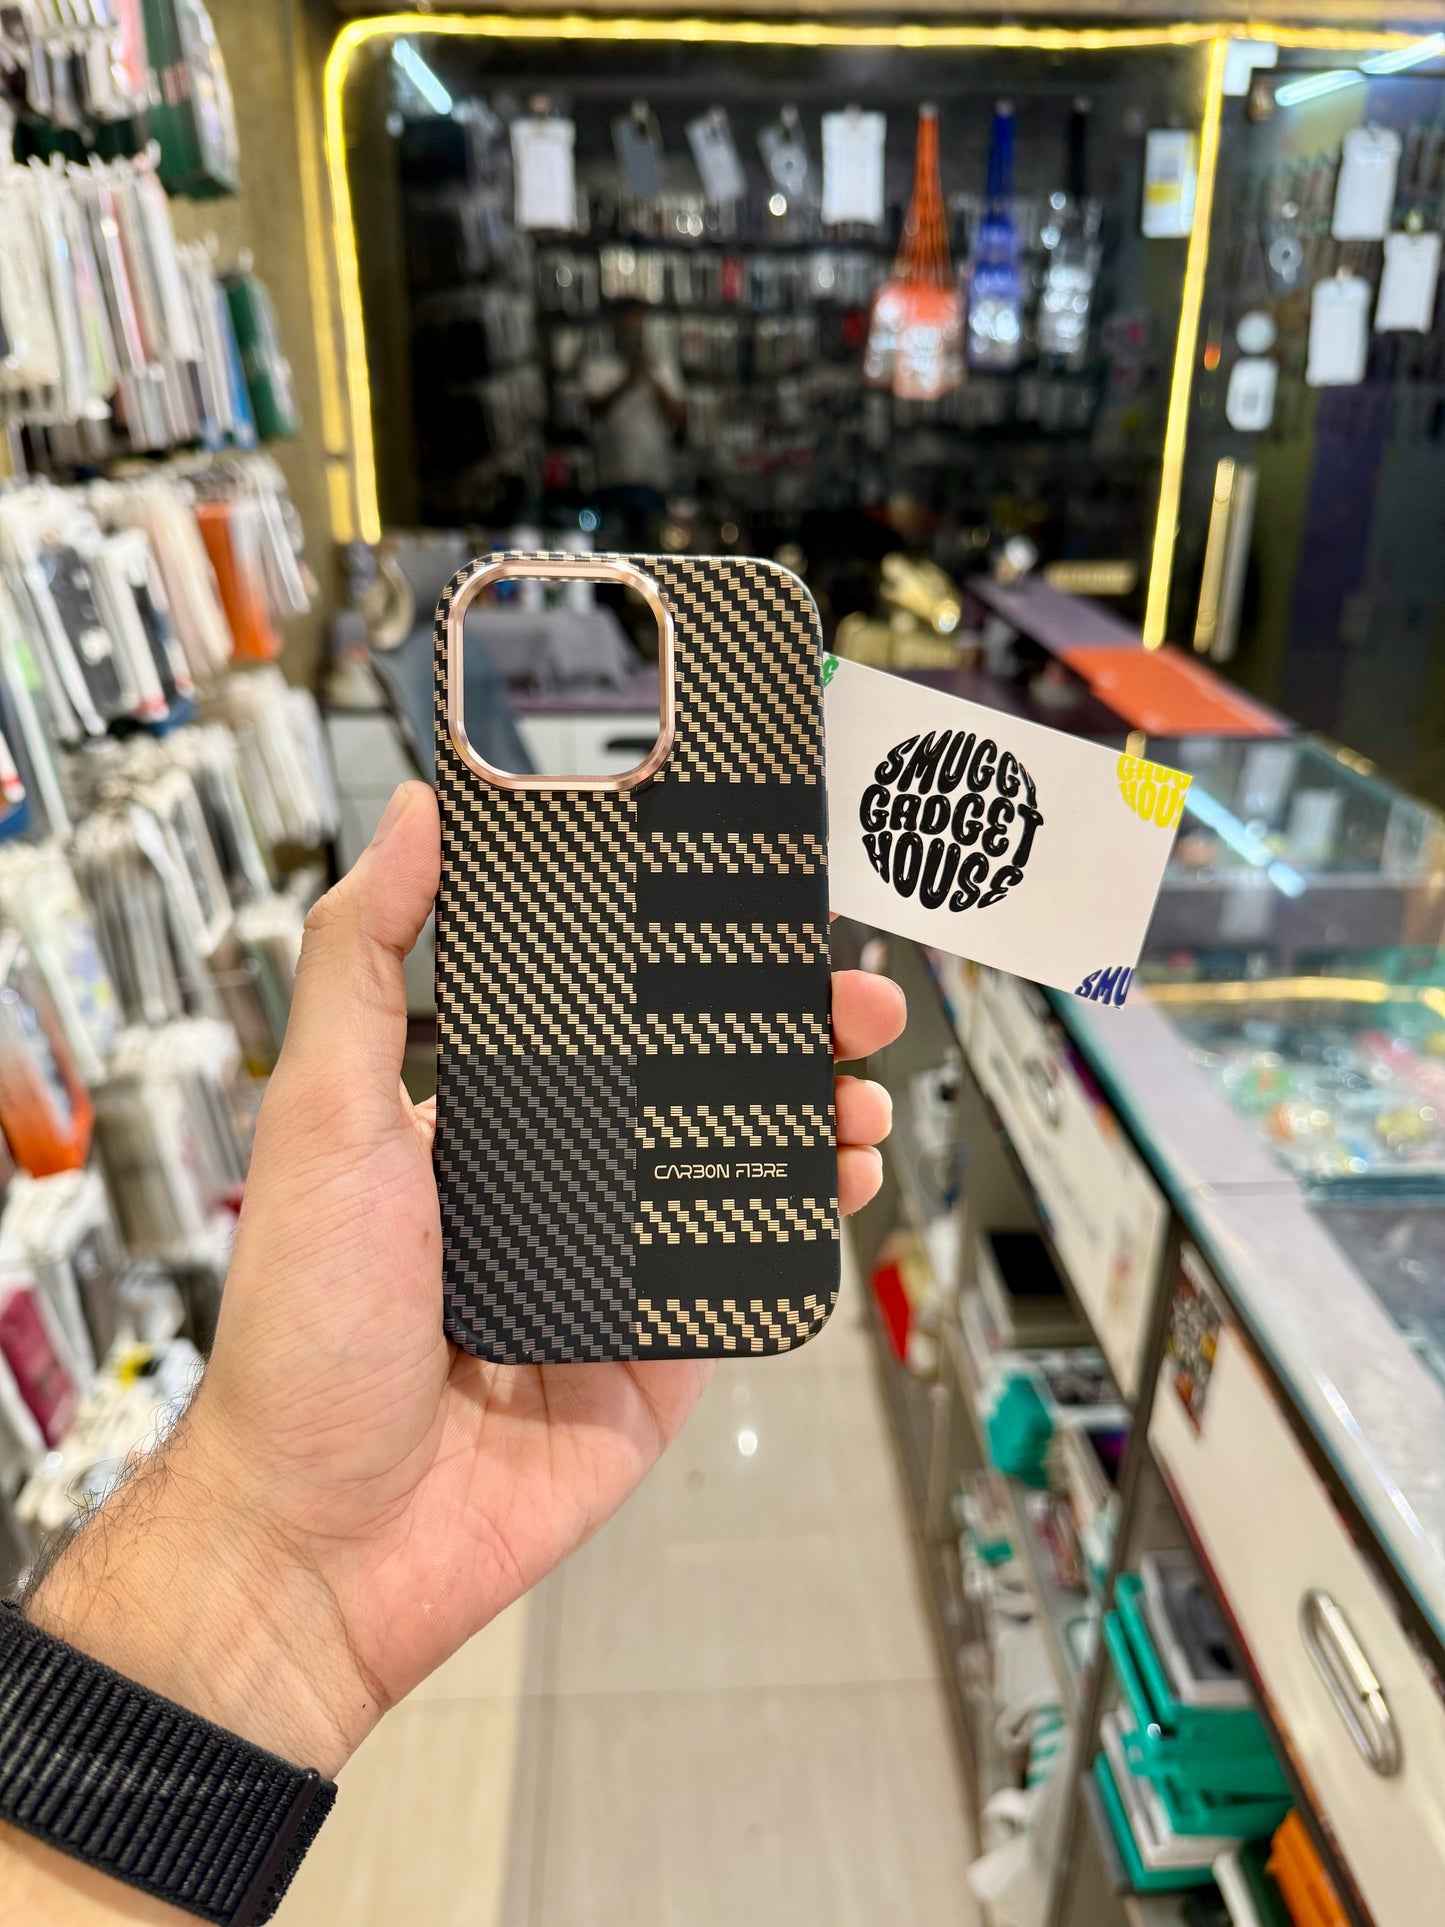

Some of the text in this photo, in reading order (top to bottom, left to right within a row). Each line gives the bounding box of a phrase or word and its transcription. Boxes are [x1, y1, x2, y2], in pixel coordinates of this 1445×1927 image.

[859, 783, 1044, 868] GADGET
[861, 831, 1024, 913] HOUSE
[654, 1162, 788, 1180] CARBON FIBRE
